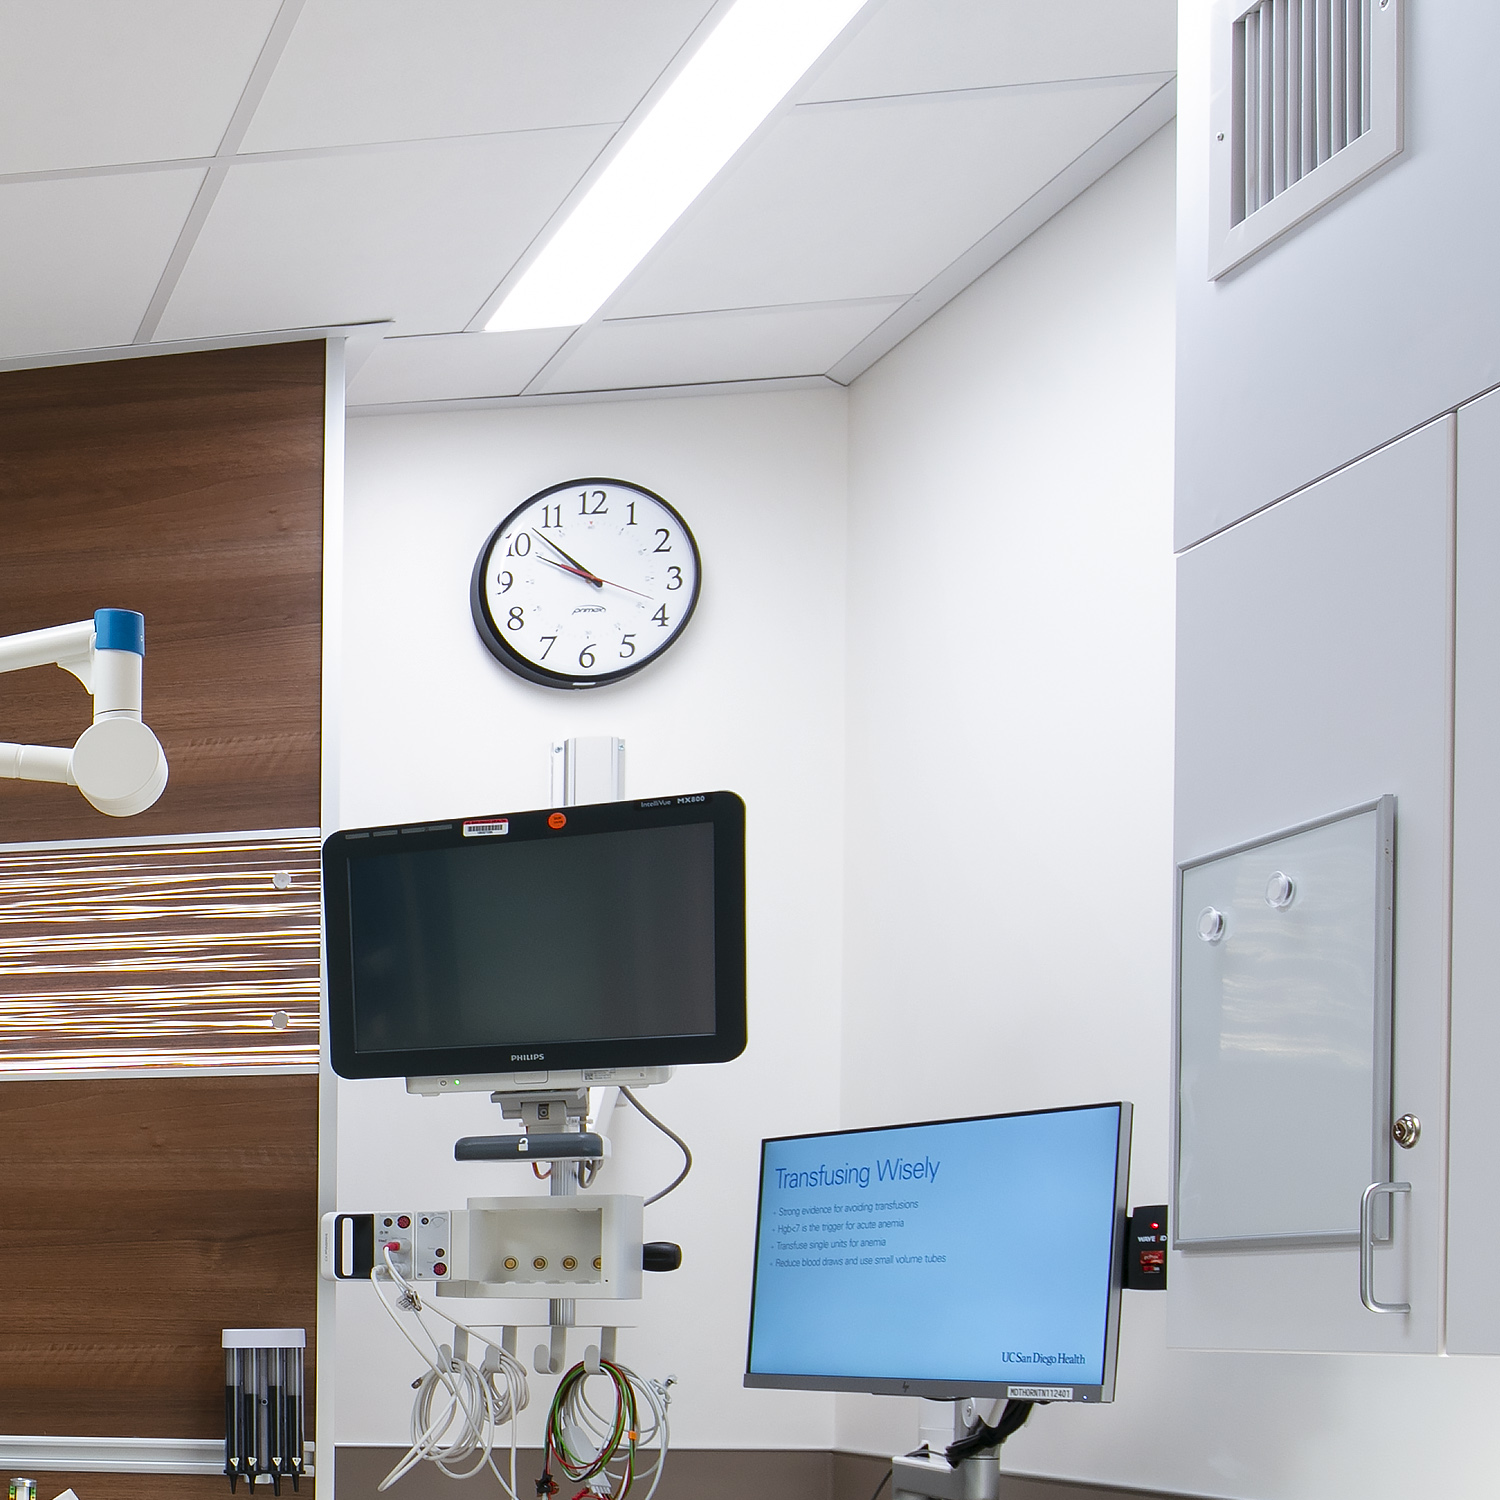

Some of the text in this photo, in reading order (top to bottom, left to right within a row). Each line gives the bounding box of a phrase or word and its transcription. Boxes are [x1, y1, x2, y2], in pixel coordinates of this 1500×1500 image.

[578, 491, 608, 514] 12
[626, 502, 638, 525] 1
[542, 504, 563, 528] 11
[506, 533, 531, 557] 10
[653, 528, 672, 553] 2
[496, 571, 513, 595] 9
[666, 566, 683, 590] 3
[507, 607, 524, 630] 8
[651, 603, 670, 627] 4
[540, 636, 557, 660] 7
[579, 644, 596, 668] 6
[620, 634, 636, 658] 5
[677, 795, 705, 804] MX800
[511, 1054, 544, 1062] PHILIPS
[775, 1156, 940, 1188] Transfusing Wisely
[778, 1200, 919, 1217] Strong evidence for avoiding transfusions
[778, 1219, 904, 1235] Hgb<7 is the trigger for acute anemia
[777, 1238, 886, 1250] Transfuse single units for anemia
[776, 1258, 800, 1267] Reduce
[802, 1257, 820, 1267] blood
[822, 1257, 843, 1266] draws
[845, 1256, 857, 1265] and
[875, 1255, 894, 1264] small
[896, 1254, 922, 1264] volume
[924, 1254, 946, 1263] tubes
[1002, 1352, 1085, 1366] UC San Diego Health
